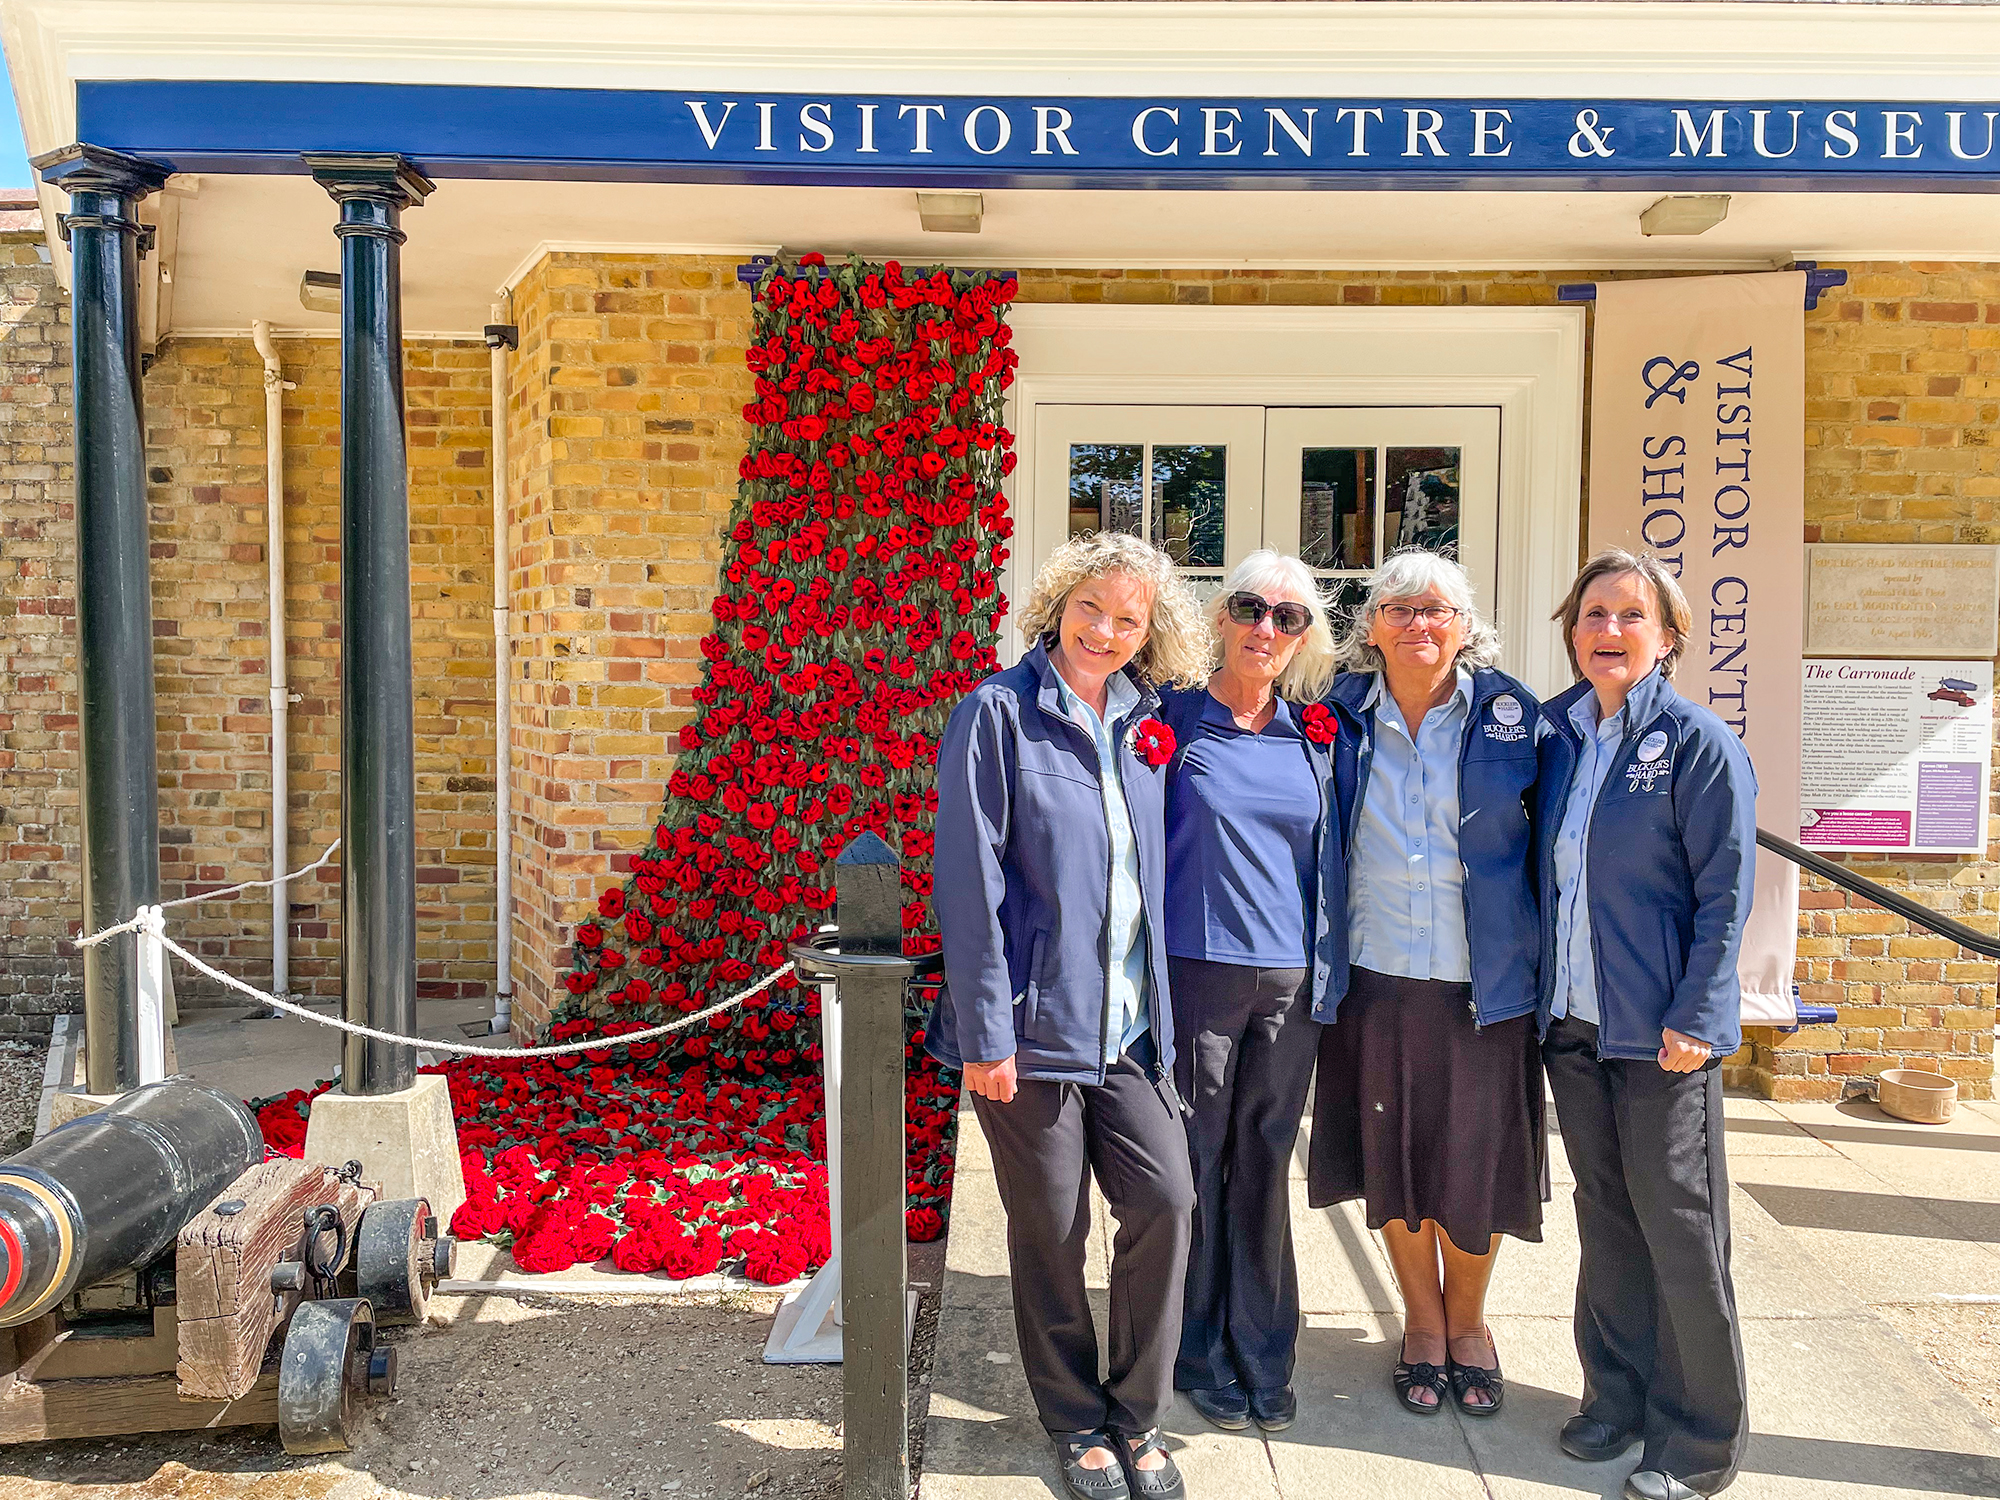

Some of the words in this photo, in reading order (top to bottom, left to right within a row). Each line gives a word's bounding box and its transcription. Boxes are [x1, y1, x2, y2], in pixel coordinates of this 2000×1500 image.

[684, 101, 1080, 155] VISITOR
[1130, 107, 1513, 158] CENTRE
[1566, 108, 1616, 159] &
[1669, 109, 2000, 160] MUSEU
[1641, 355, 1700, 409] &
[1712, 346, 1753, 558] VISITOR
[1883, 575, 1911, 585] opened
[1913, 574, 1923, 585] by
[1806, 664, 1832, 679] The
[1838, 664, 1916, 680] Carronade
[1494, 732, 1518, 742] HARD
